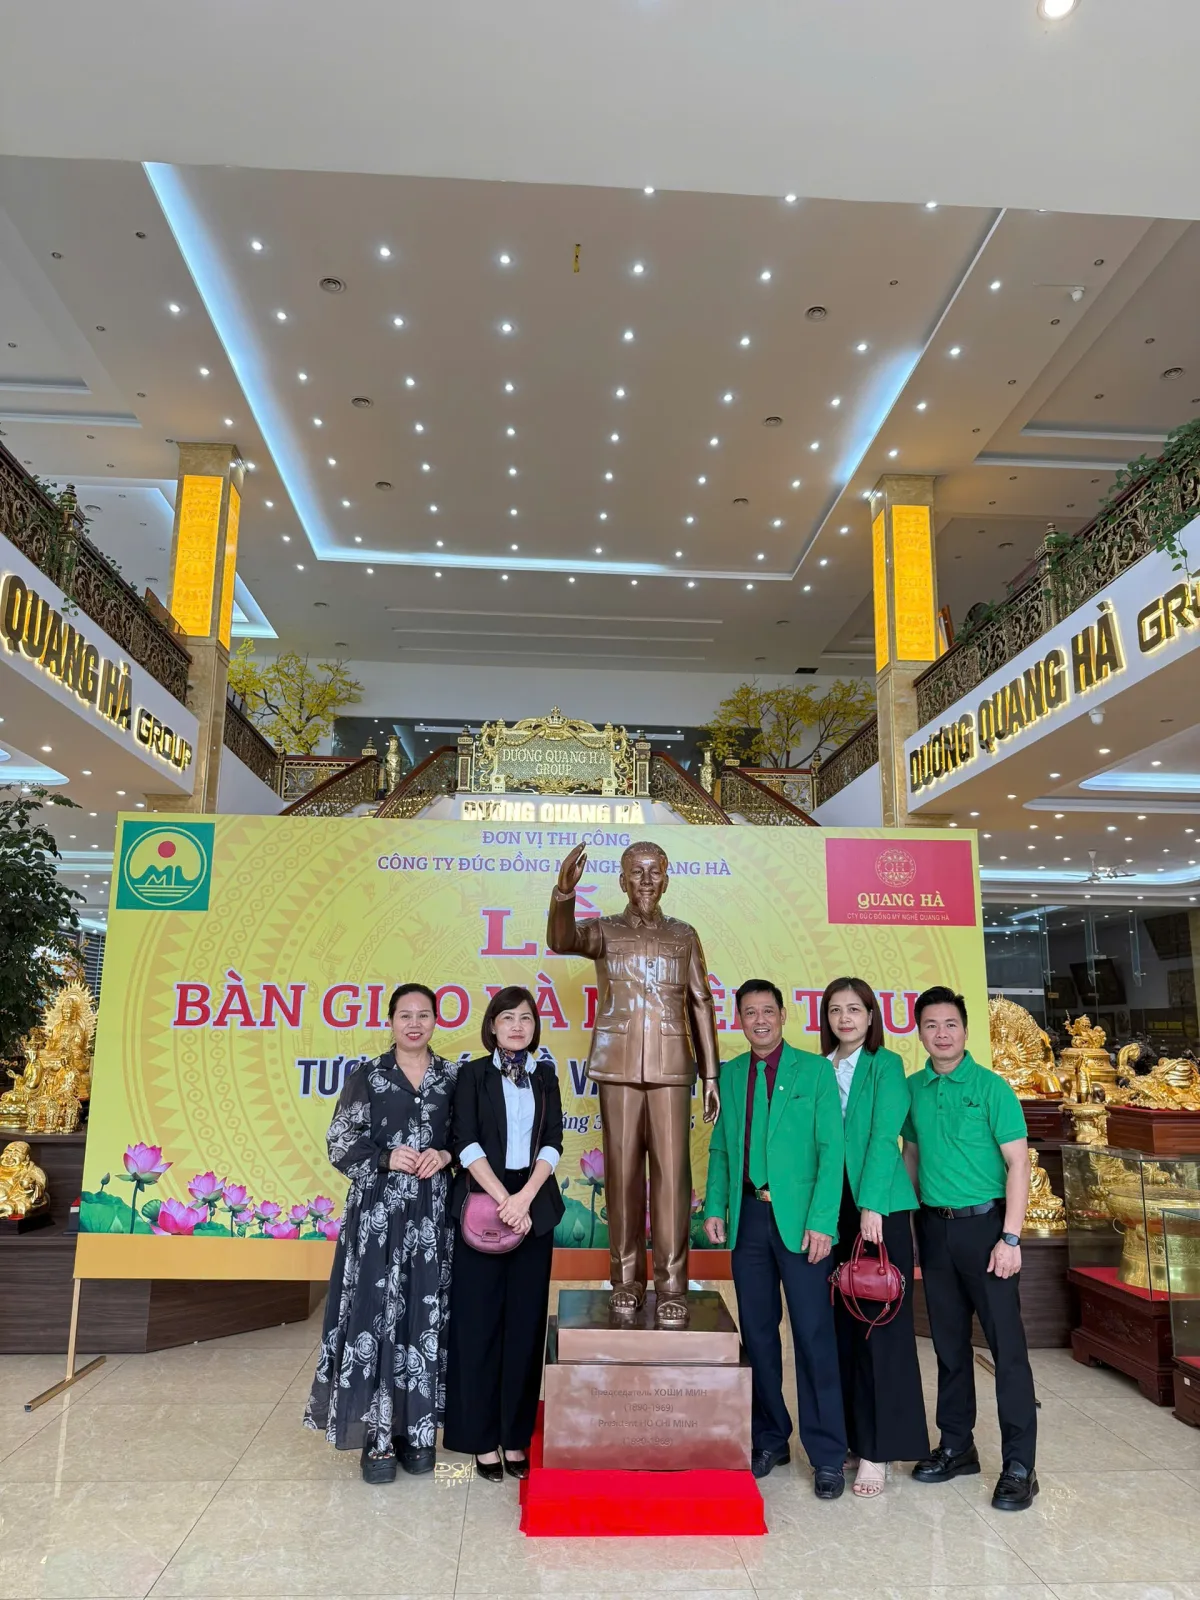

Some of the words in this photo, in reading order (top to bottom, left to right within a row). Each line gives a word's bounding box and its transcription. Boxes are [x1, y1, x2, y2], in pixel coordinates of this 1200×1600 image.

[0, 573, 99, 706] QUANG
[97, 658, 133, 731] HÀ
[136, 706, 193, 771] GROUP
[977, 649, 1069, 753] QUANG
[1071, 600, 1127, 695] HÀ
[545, 749, 587, 764] QUANG
[535, 763, 572, 776] GROUP
[482, 830, 522, 845] ĐƠN
[525, 831, 543, 848] VỊ
[546, 831, 578, 846] THI
[581, 828, 631, 847] CÔNG
[377, 852, 428, 871] CÔNG
[432, 857, 455, 871] TY
[458, 853, 496, 872] ĐÚC
[499, 851, 551, 872] ĐỒNG
[667, 862, 701, 875] ANG
[708, 857, 732, 876] HÀ
[857, 892, 916, 909] QUANG
[919, 891, 946, 907] HÀ
[919, 913, 940, 921] QUANG
[173, 969, 305, 1028] BÀN
[322, 983, 471, 1029] GIO
[795, 989, 919, 1034] TU
[562, 1112, 590, 1133] áng
[685, 1388, 708, 1397] МИН
[598, 1419, 637, 1428] President
[655, 1420, 671, 1428] CHI
[673, 1420, 698, 1428] MINH
